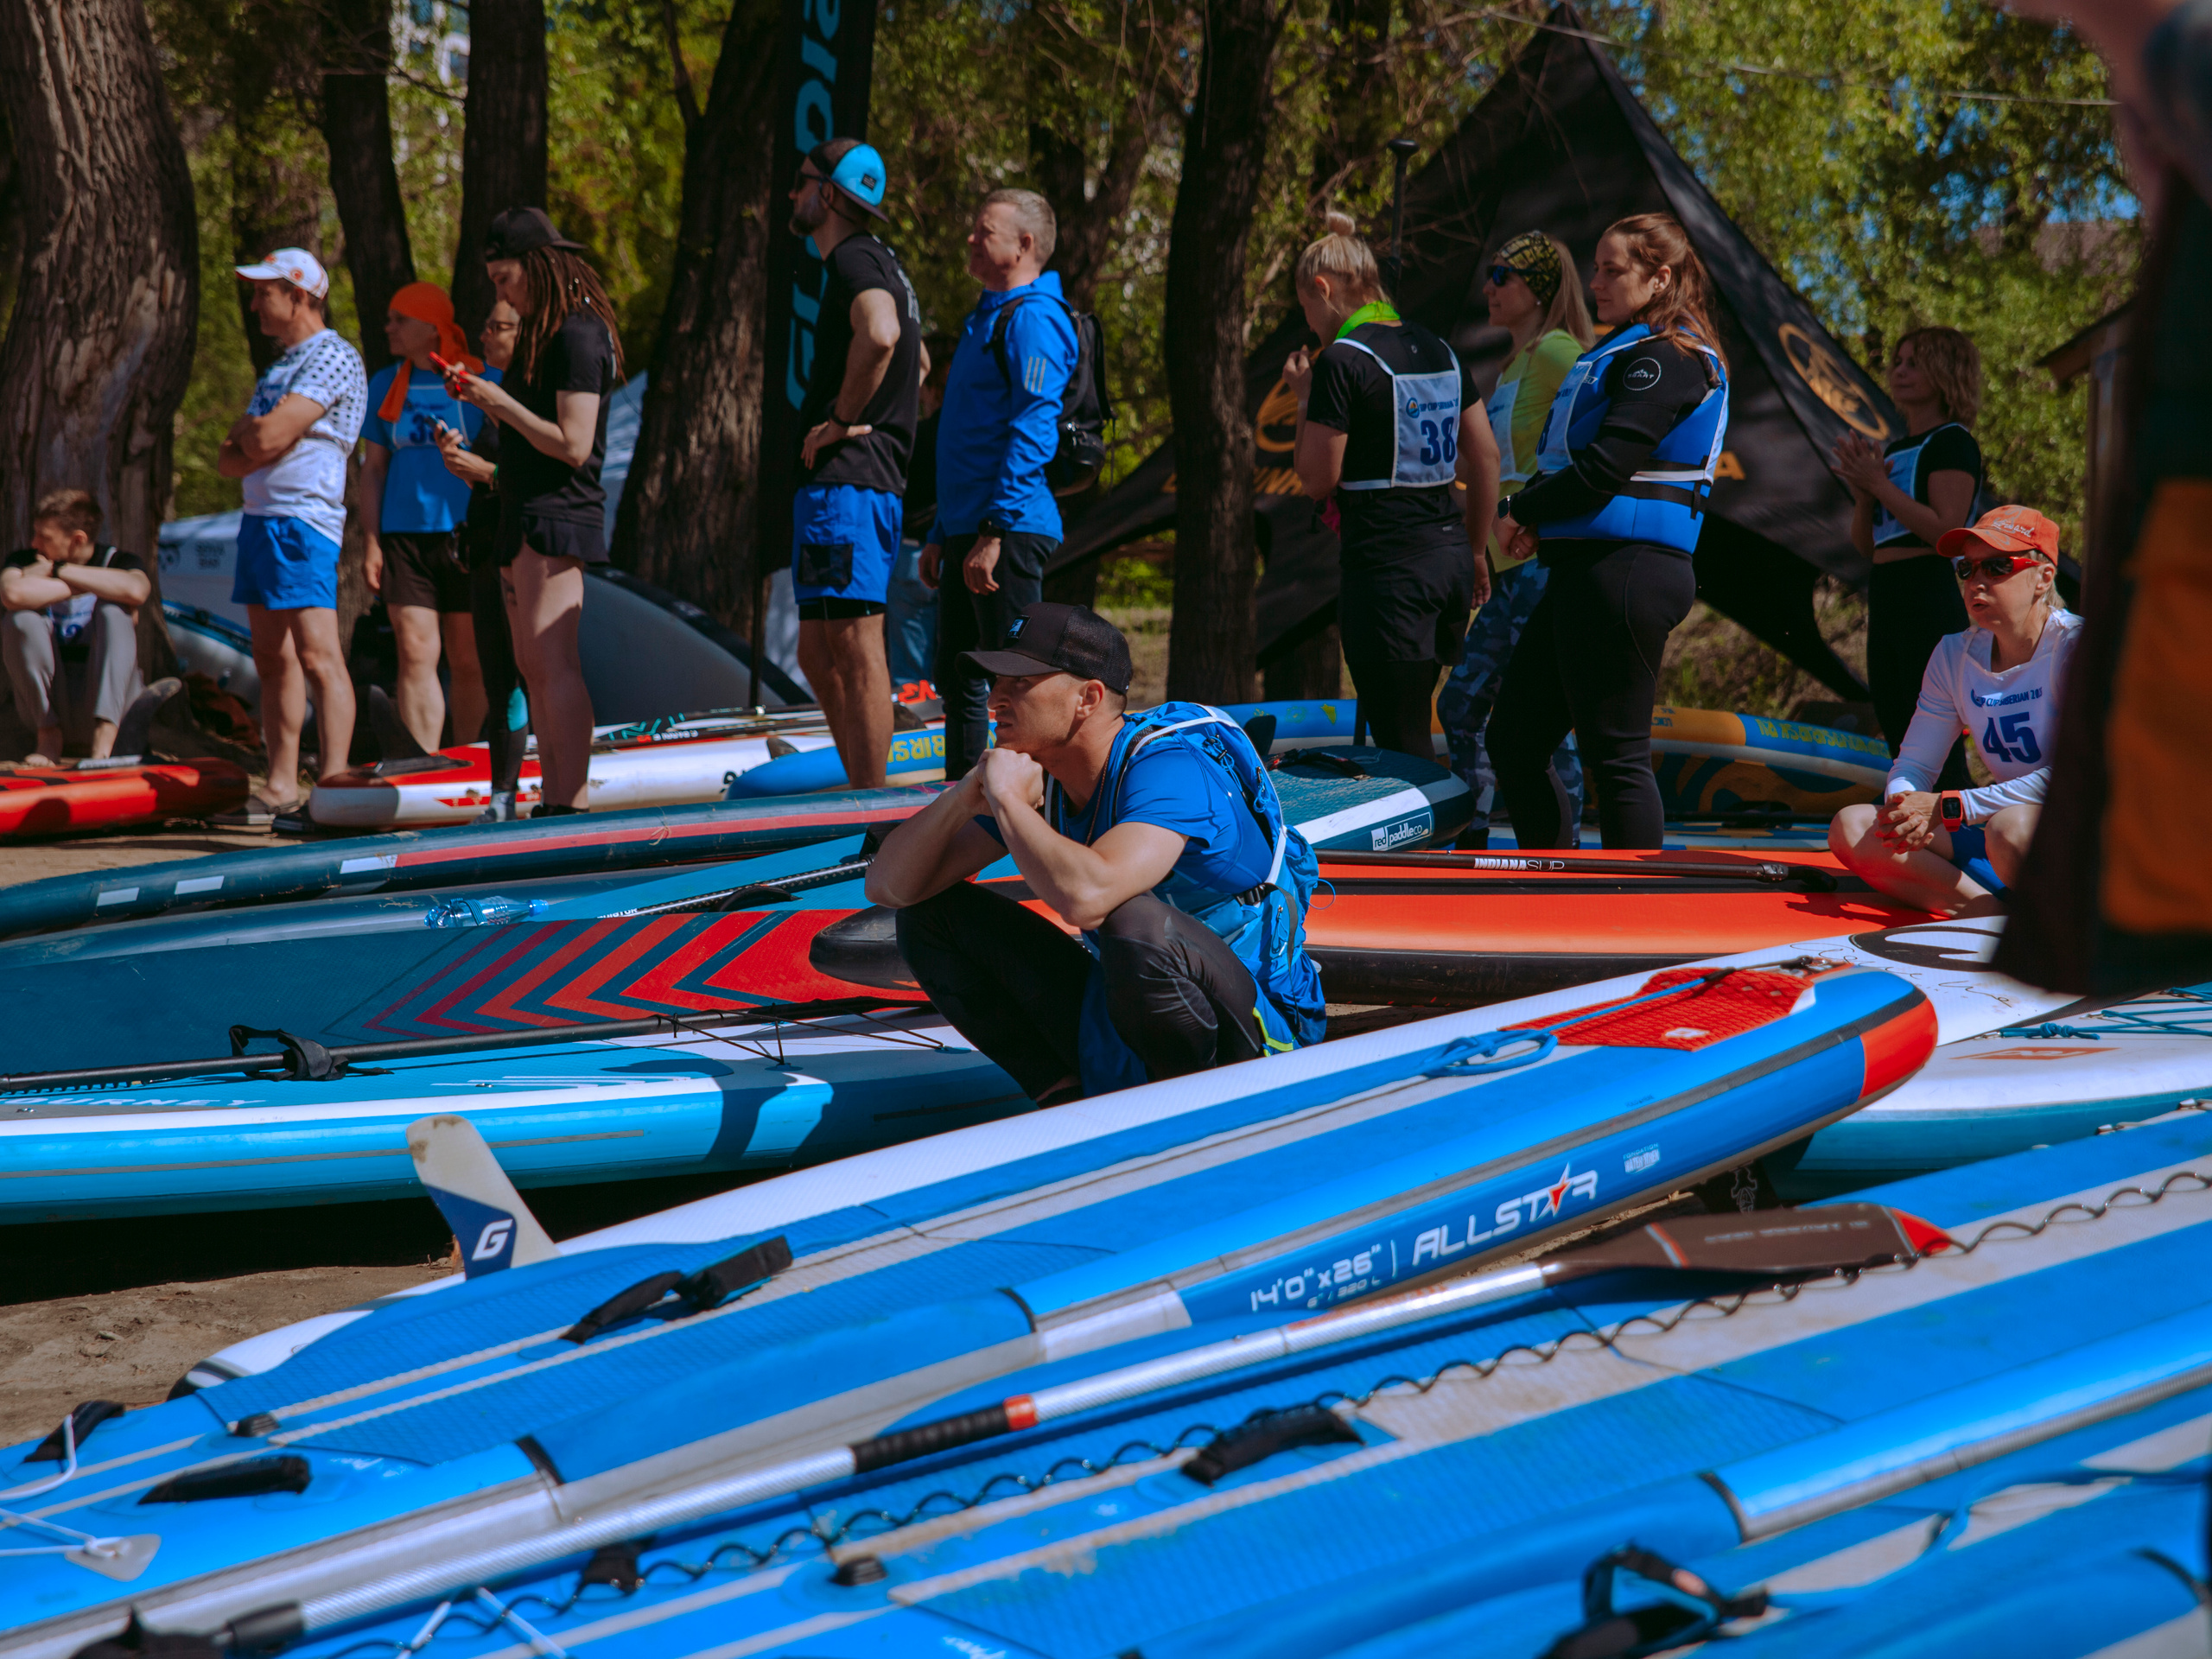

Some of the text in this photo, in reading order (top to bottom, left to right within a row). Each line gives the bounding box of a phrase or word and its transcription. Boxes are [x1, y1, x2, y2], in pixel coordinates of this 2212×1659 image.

[1420, 416, 1456, 466] 38
[1982, 711, 2042, 765] 45
[1389, 821, 1423, 845] paddleco
[0, 1097, 267, 1107] OURNEY
[1412, 1162, 1599, 1266] ALLSTAR
[472, 1218, 512, 1261] G
